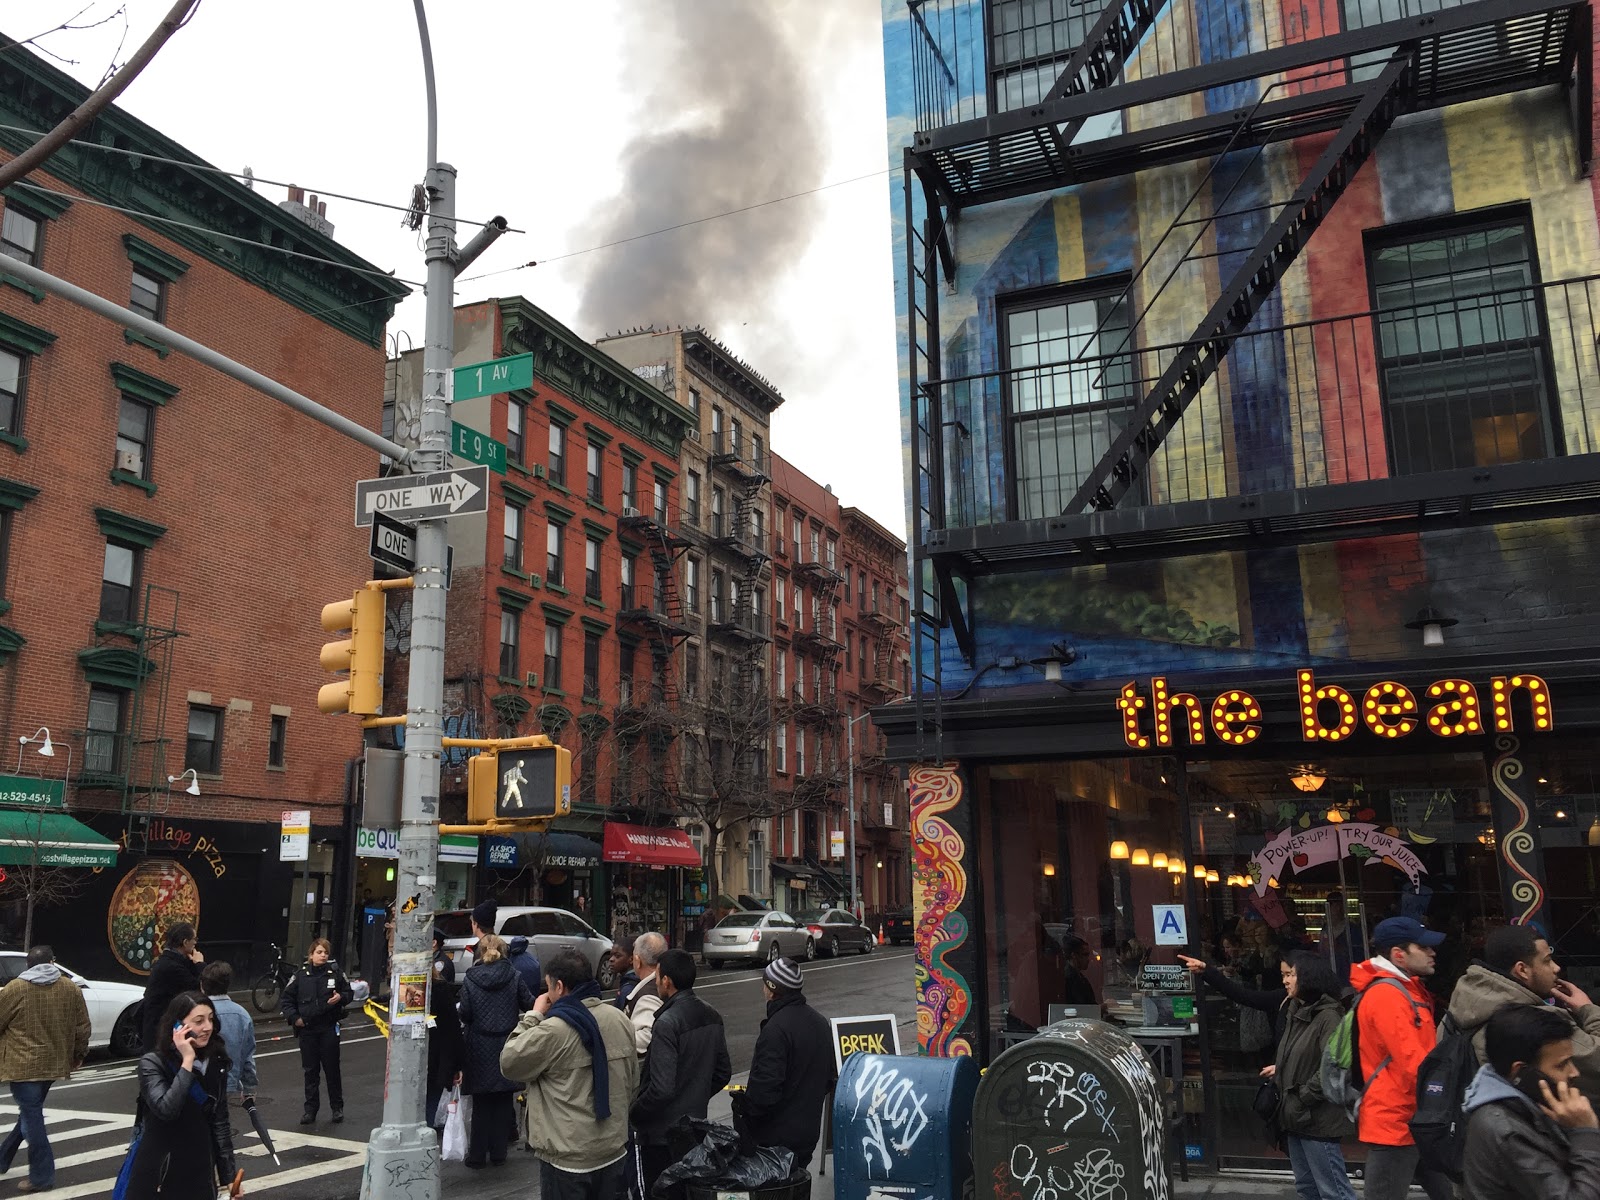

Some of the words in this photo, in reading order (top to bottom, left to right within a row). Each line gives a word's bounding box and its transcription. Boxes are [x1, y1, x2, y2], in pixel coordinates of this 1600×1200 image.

[475, 367, 483, 393] 1
[459, 428, 467, 454] E
[474, 436, 482, 460] 9
[376, 490, 412, 510] ONE
[430, 482, 468, 504] WAY
[384, 531, 408, 556] ONE
[1116, 676, 1263, 748] the
[1297, 669, 1553, 742] bean
[1264, 831, 1329, 865] POWER-UP!
[1342, 827, 1369, 842] TRY
[1371, 834, 1393, 849] OUR
[1160, 910, 1181, 934] A
[1140, 981, 1156, 989] 7am
[1160, 980, 1188, 990] Midnight
[1142, 973, 1160, 981] OPEN
[1161, 973, 1166, 981] 7
[1167, 973, 1185, 981] DAYS
